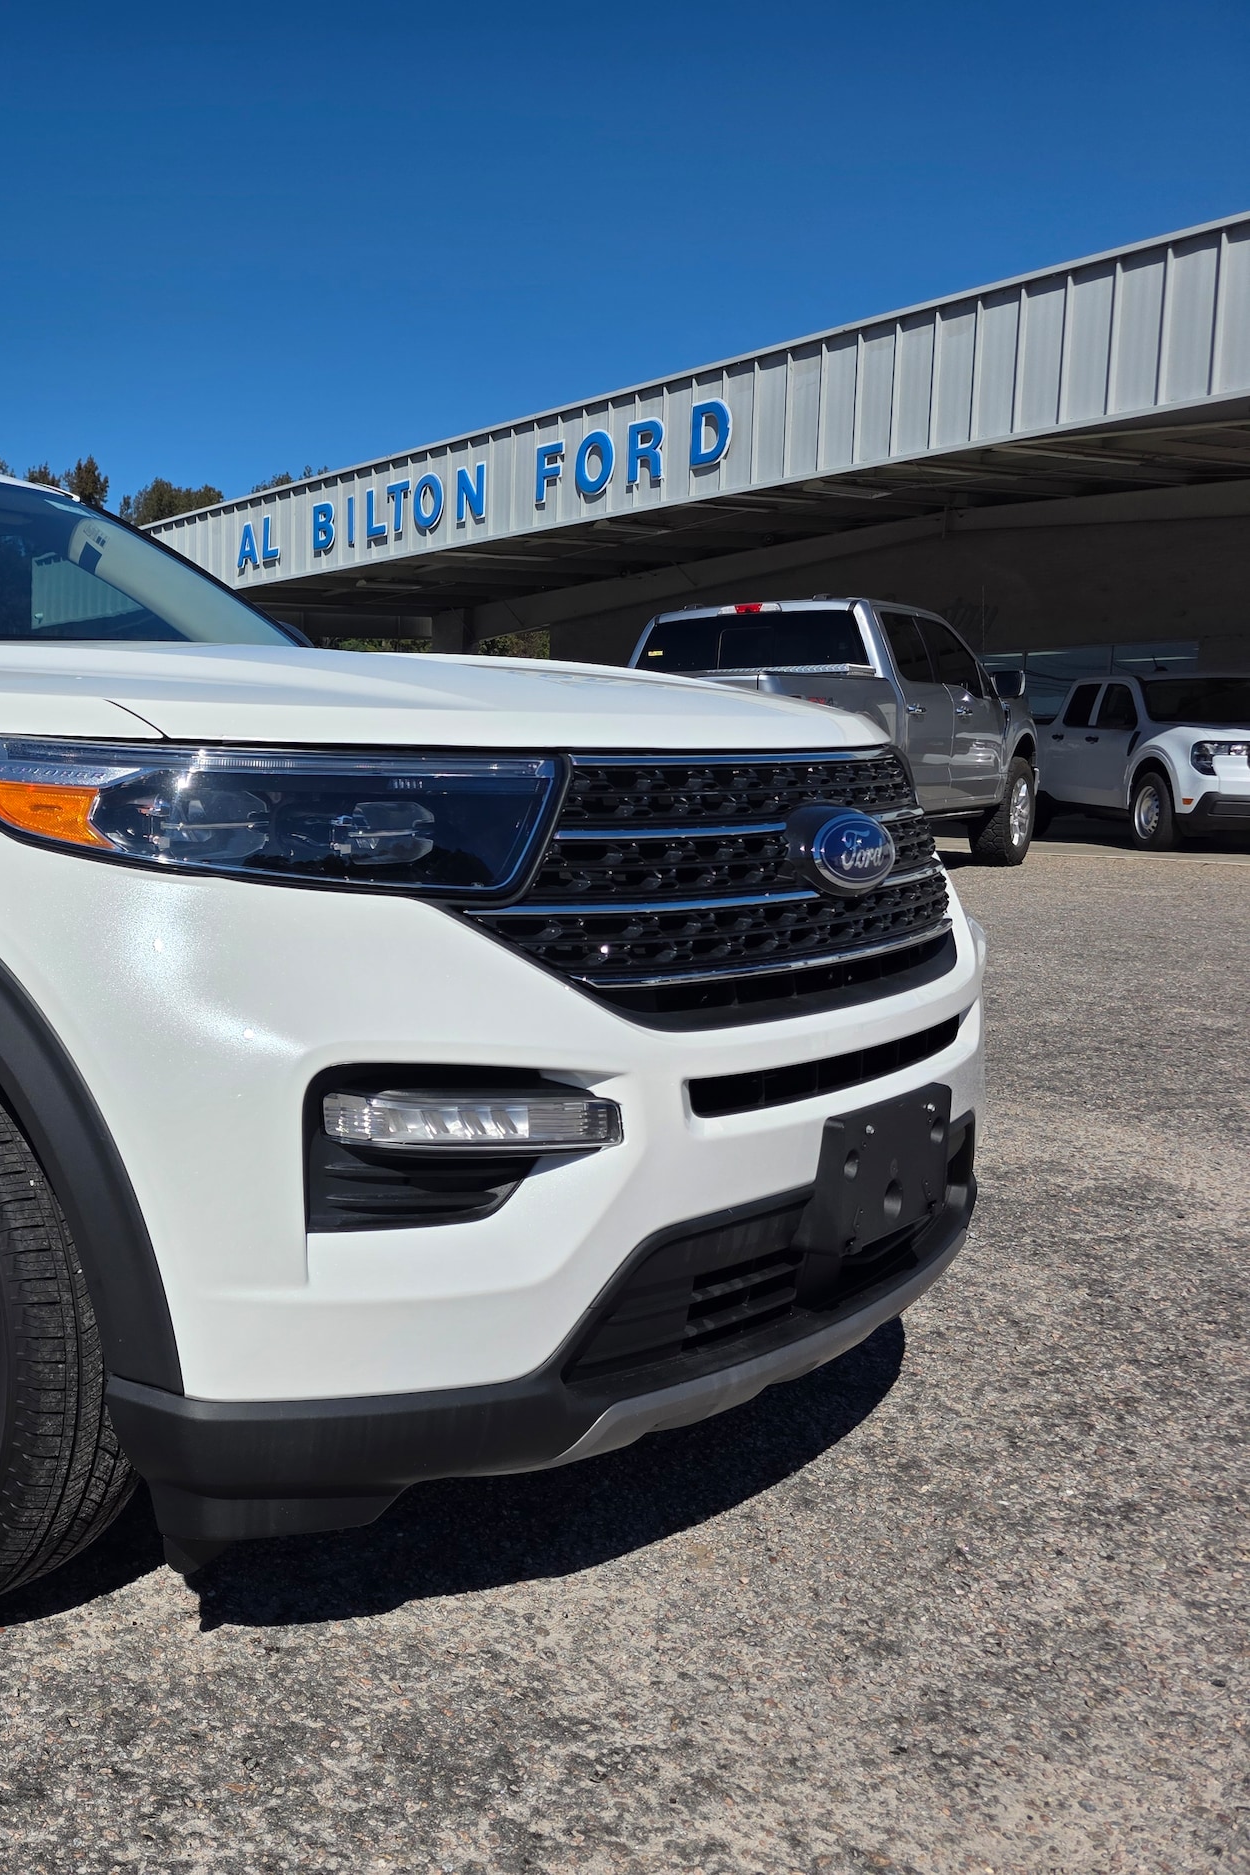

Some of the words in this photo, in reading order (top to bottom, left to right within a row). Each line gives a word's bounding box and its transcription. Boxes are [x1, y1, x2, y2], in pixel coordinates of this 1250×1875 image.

[237, 515, 280, 569] AL
[312, 461, 487, 552] BILTON
[535, 397, 734, 504] FORD
[840, 829, 884, 871] Ford
